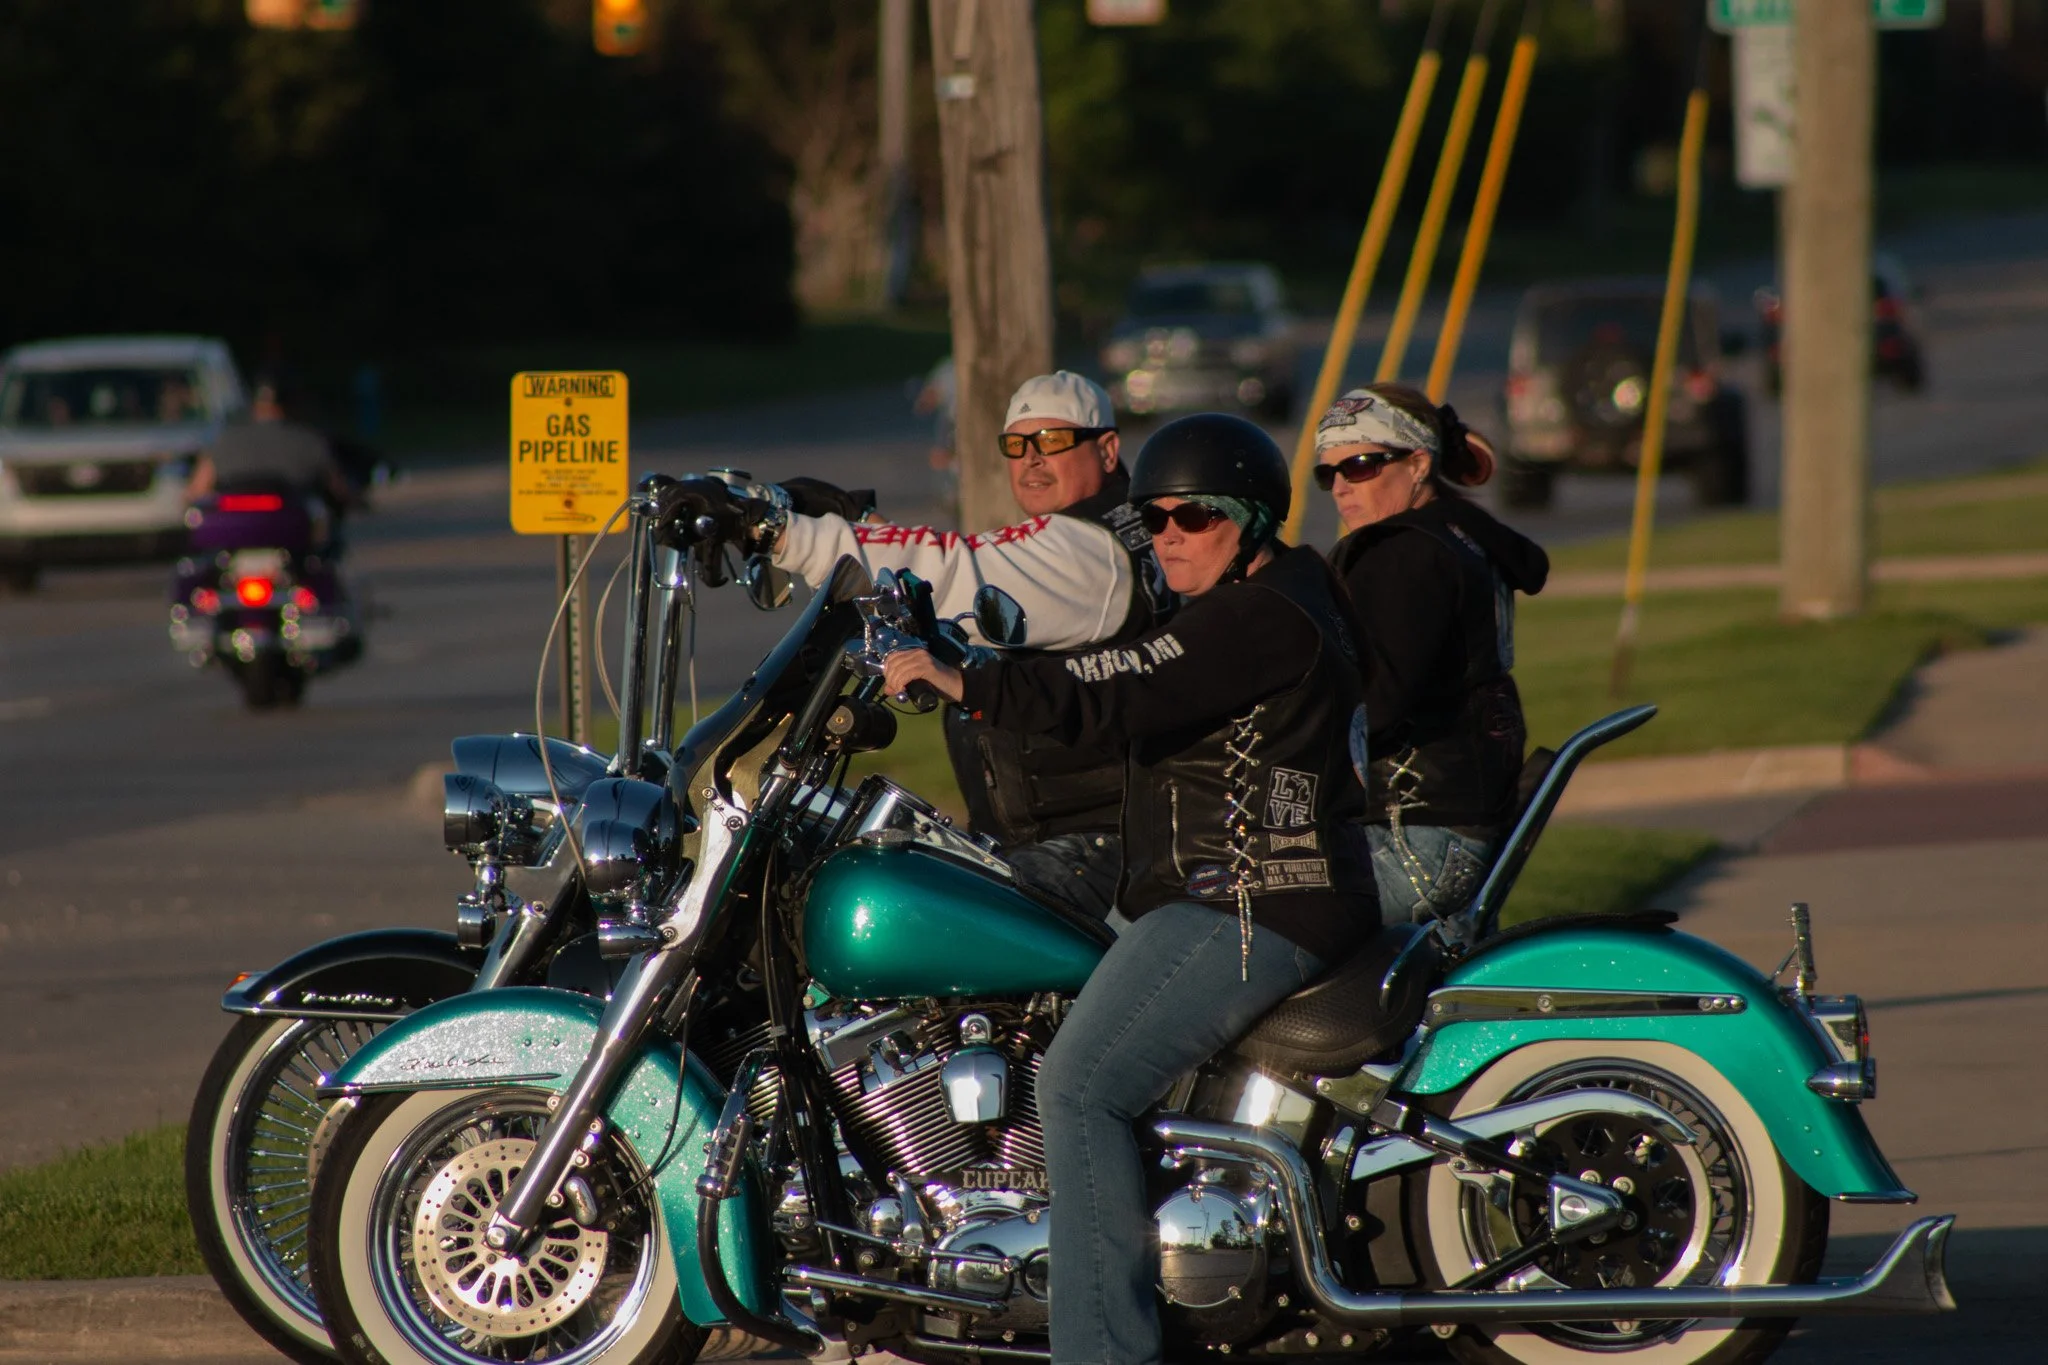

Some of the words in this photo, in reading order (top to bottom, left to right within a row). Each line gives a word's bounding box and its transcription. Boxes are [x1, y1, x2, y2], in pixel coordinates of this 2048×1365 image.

[530, 377, 610, 395] WARNING
[547, 414, 590, 437] GAS
[519, 440, 619, 463] PIPELINE
[1267, 864, 1280, 875] MY
[1283, 862, 1322, 873] VIBRATOR
[1267, 875, 1284, 886] HAS
[1287, 874, 1294, 884] 2
[1296, 872, 1326, 884] WHEELS
